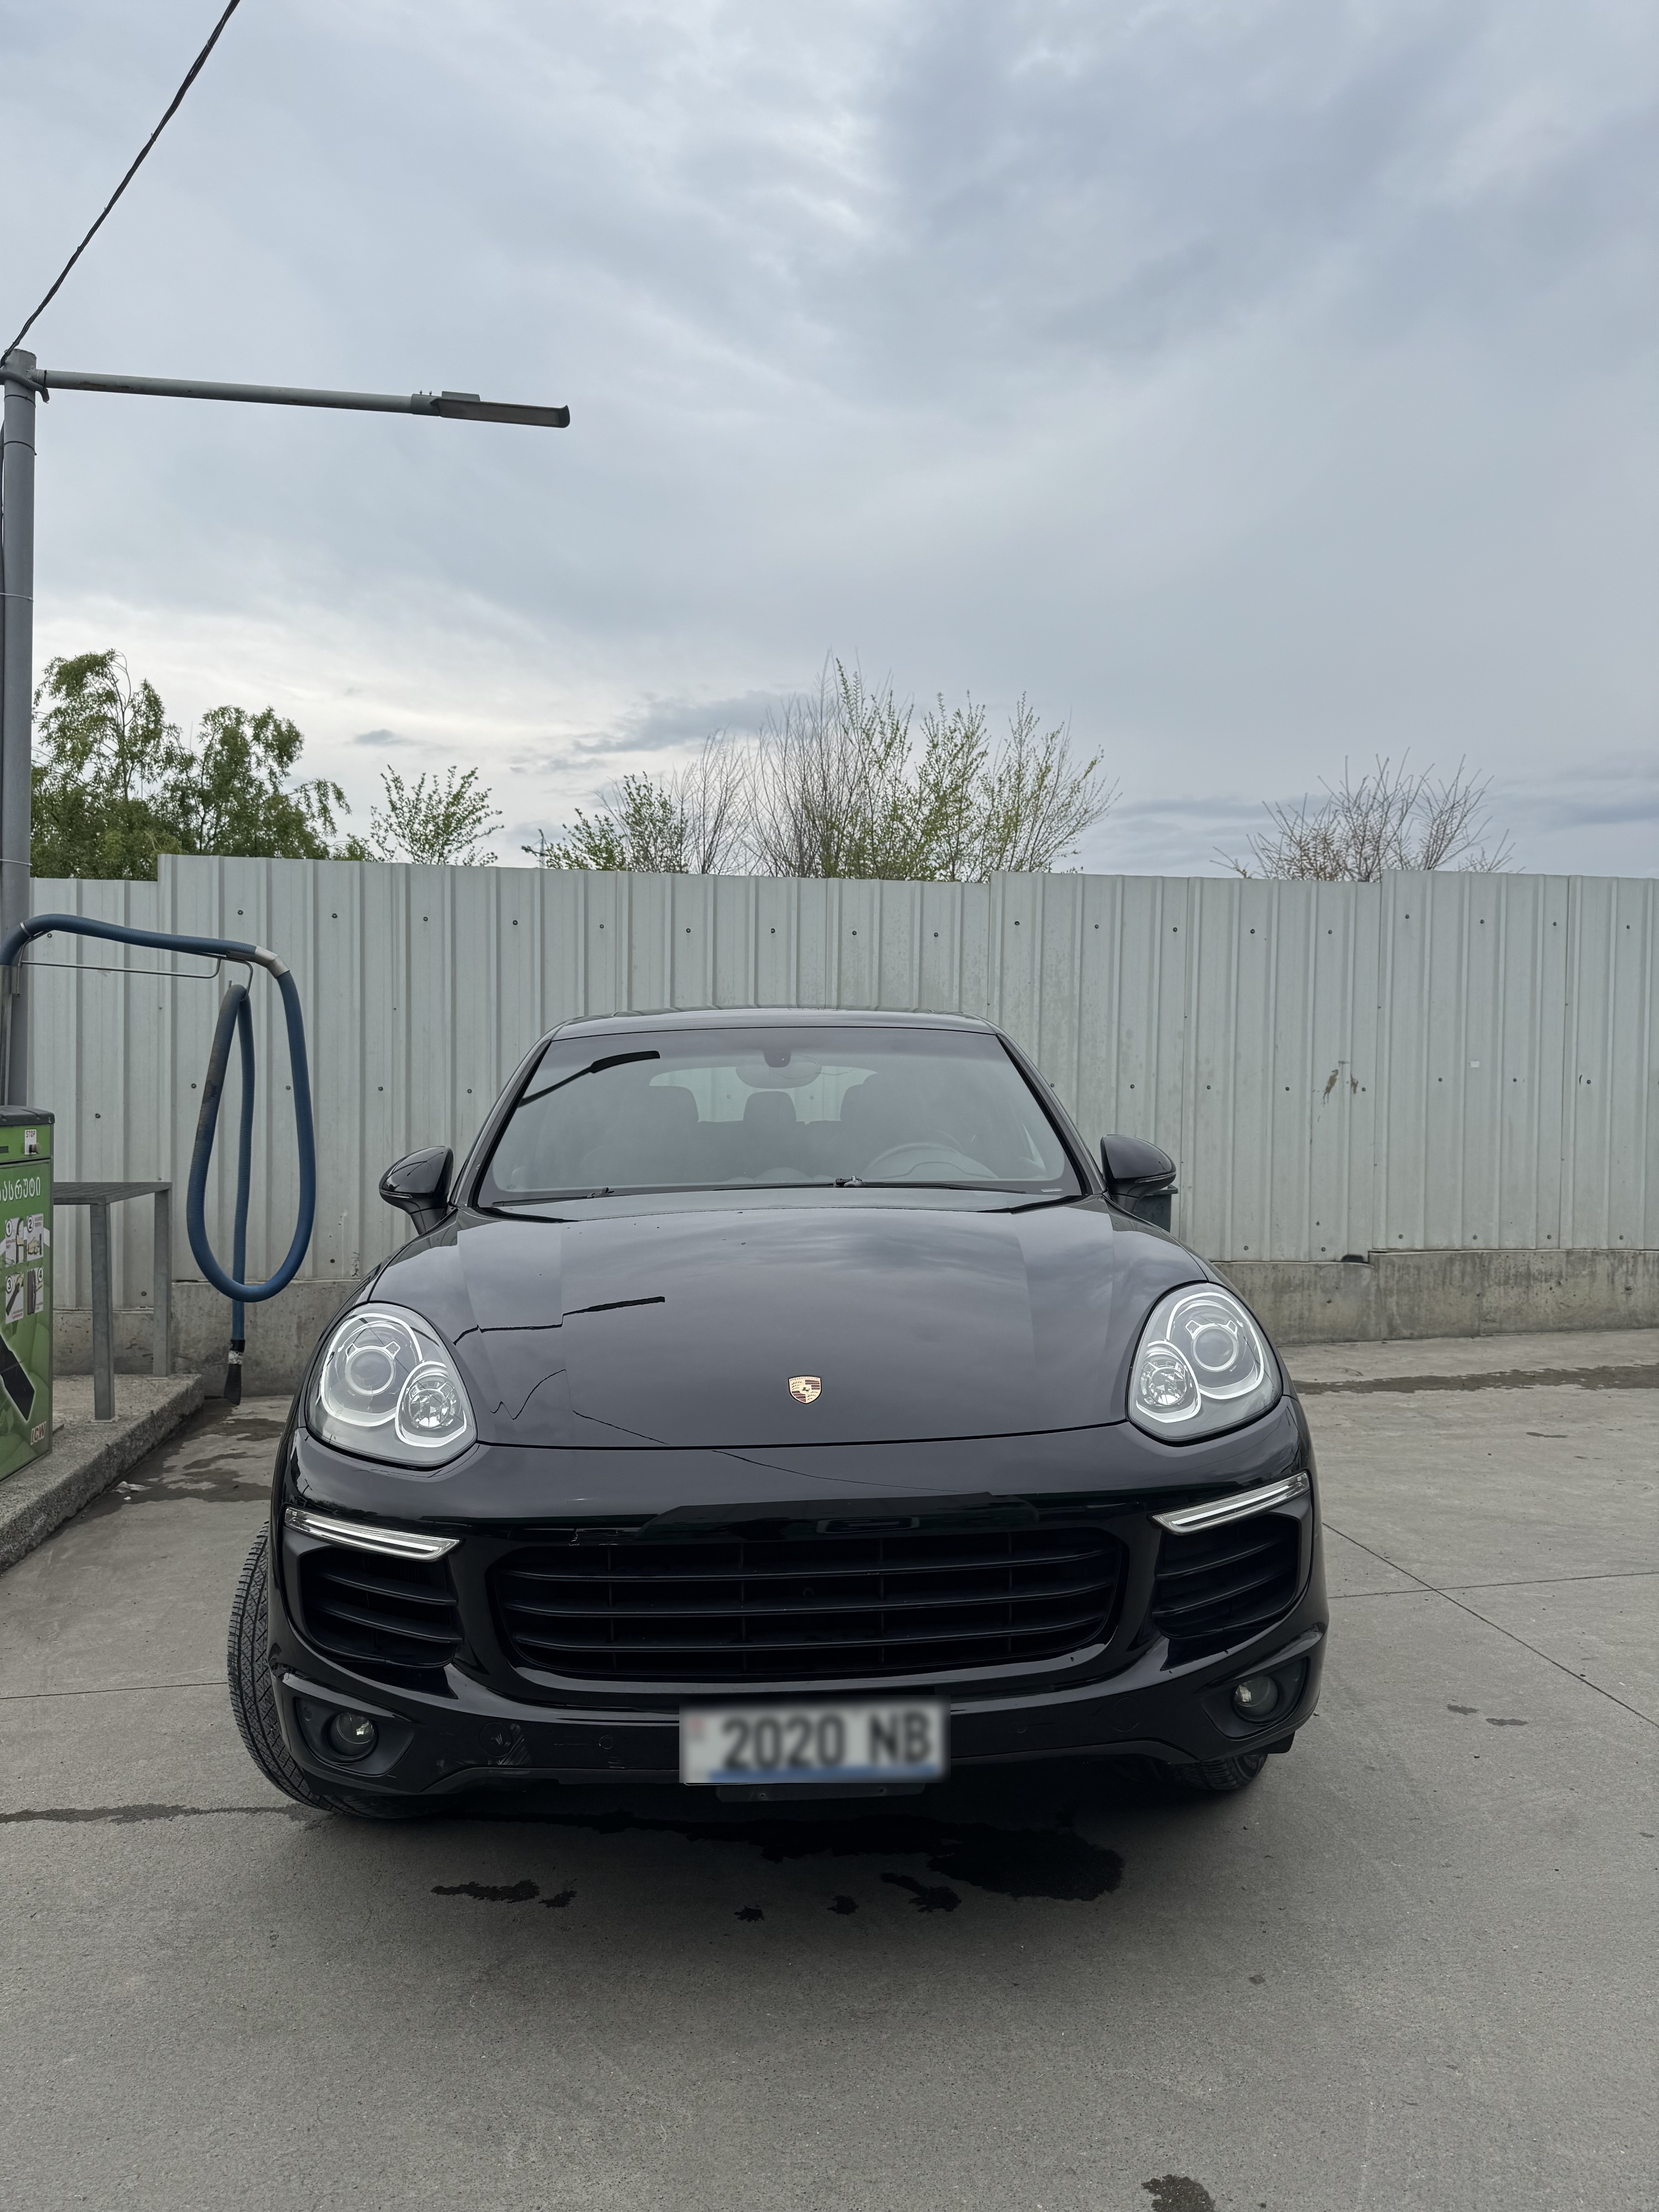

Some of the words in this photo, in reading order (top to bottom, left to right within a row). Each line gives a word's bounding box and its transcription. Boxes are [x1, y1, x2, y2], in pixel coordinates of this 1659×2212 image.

[0, 1176, 40, 1202] ასრუტი
[8, 1223, 10, 1233] 1
[29, 1219, 32, 1229] 2
[39, 1269, 42, 1278] 4
[7, 1279, 11, 1290] 3
[31, 1422, 46, 1444] ICW
[721, 1713, 847, 1772] 2020
